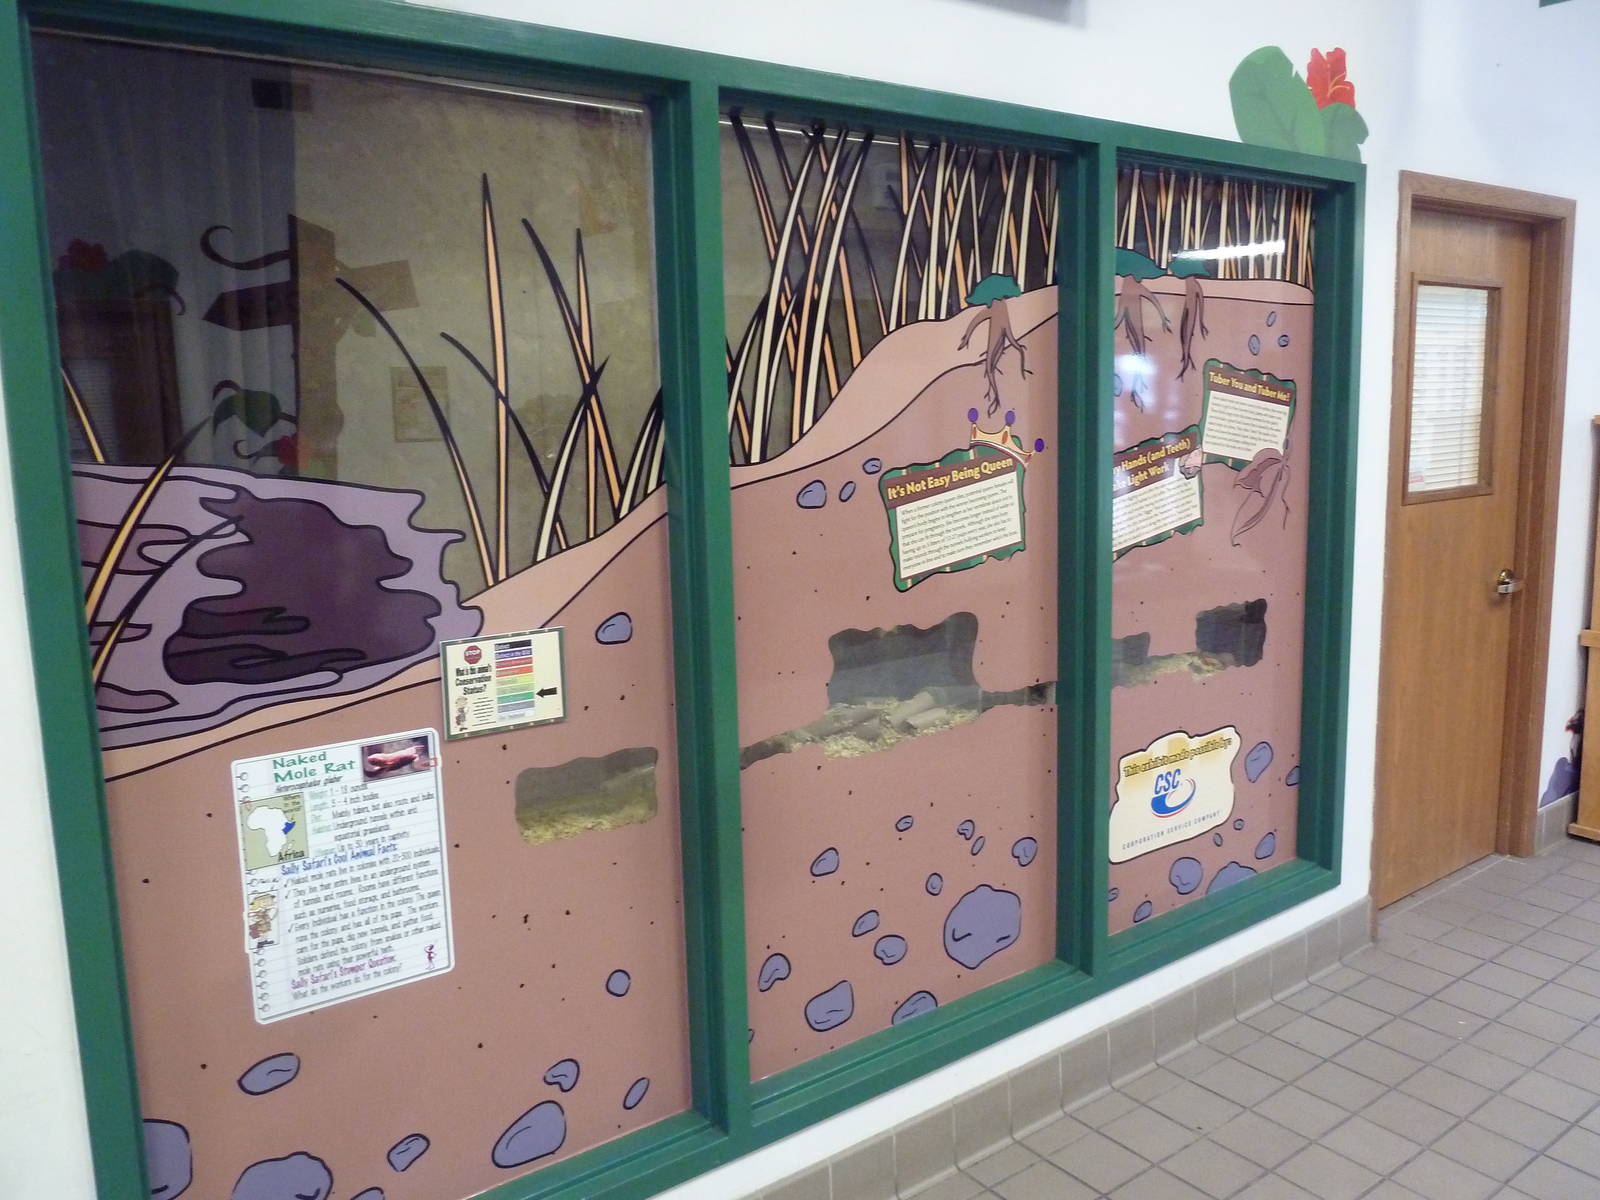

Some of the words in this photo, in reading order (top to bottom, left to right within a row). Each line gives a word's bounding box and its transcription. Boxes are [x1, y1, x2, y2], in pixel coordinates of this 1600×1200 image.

[1231, 378, 1244, 390] You
[1244, 384, 1258, 393] and
[1121, 454, 1146, 471] Hands
[1147, 447, 1166, 464] (and
[1166, 438, 1190, 454] Teeth)
[888, 484, 906, 500] It's
[906, 480, 926, 495] Not
[928, 474, 950, 489] Easy
[952, 468, 980, 483] Being
[981, 458, 1013, 474] Queen
[1127, 471, 1148, 486] Light
[1148, 462, 1170, 476] Work
[272, 750, 326, 769] Naked
[274, 765, 316, 782] Mole
[324, 758, 355, 773] Rat
[1154, 768, 1182, 795] CSC
[1122, 830, 1164, 850] CORPORATION
[1166, 820, 1192, 834] SERVICE
[1194, 810, 1220, 824] COMPANY
[278, 848, 304, 861] Africa
